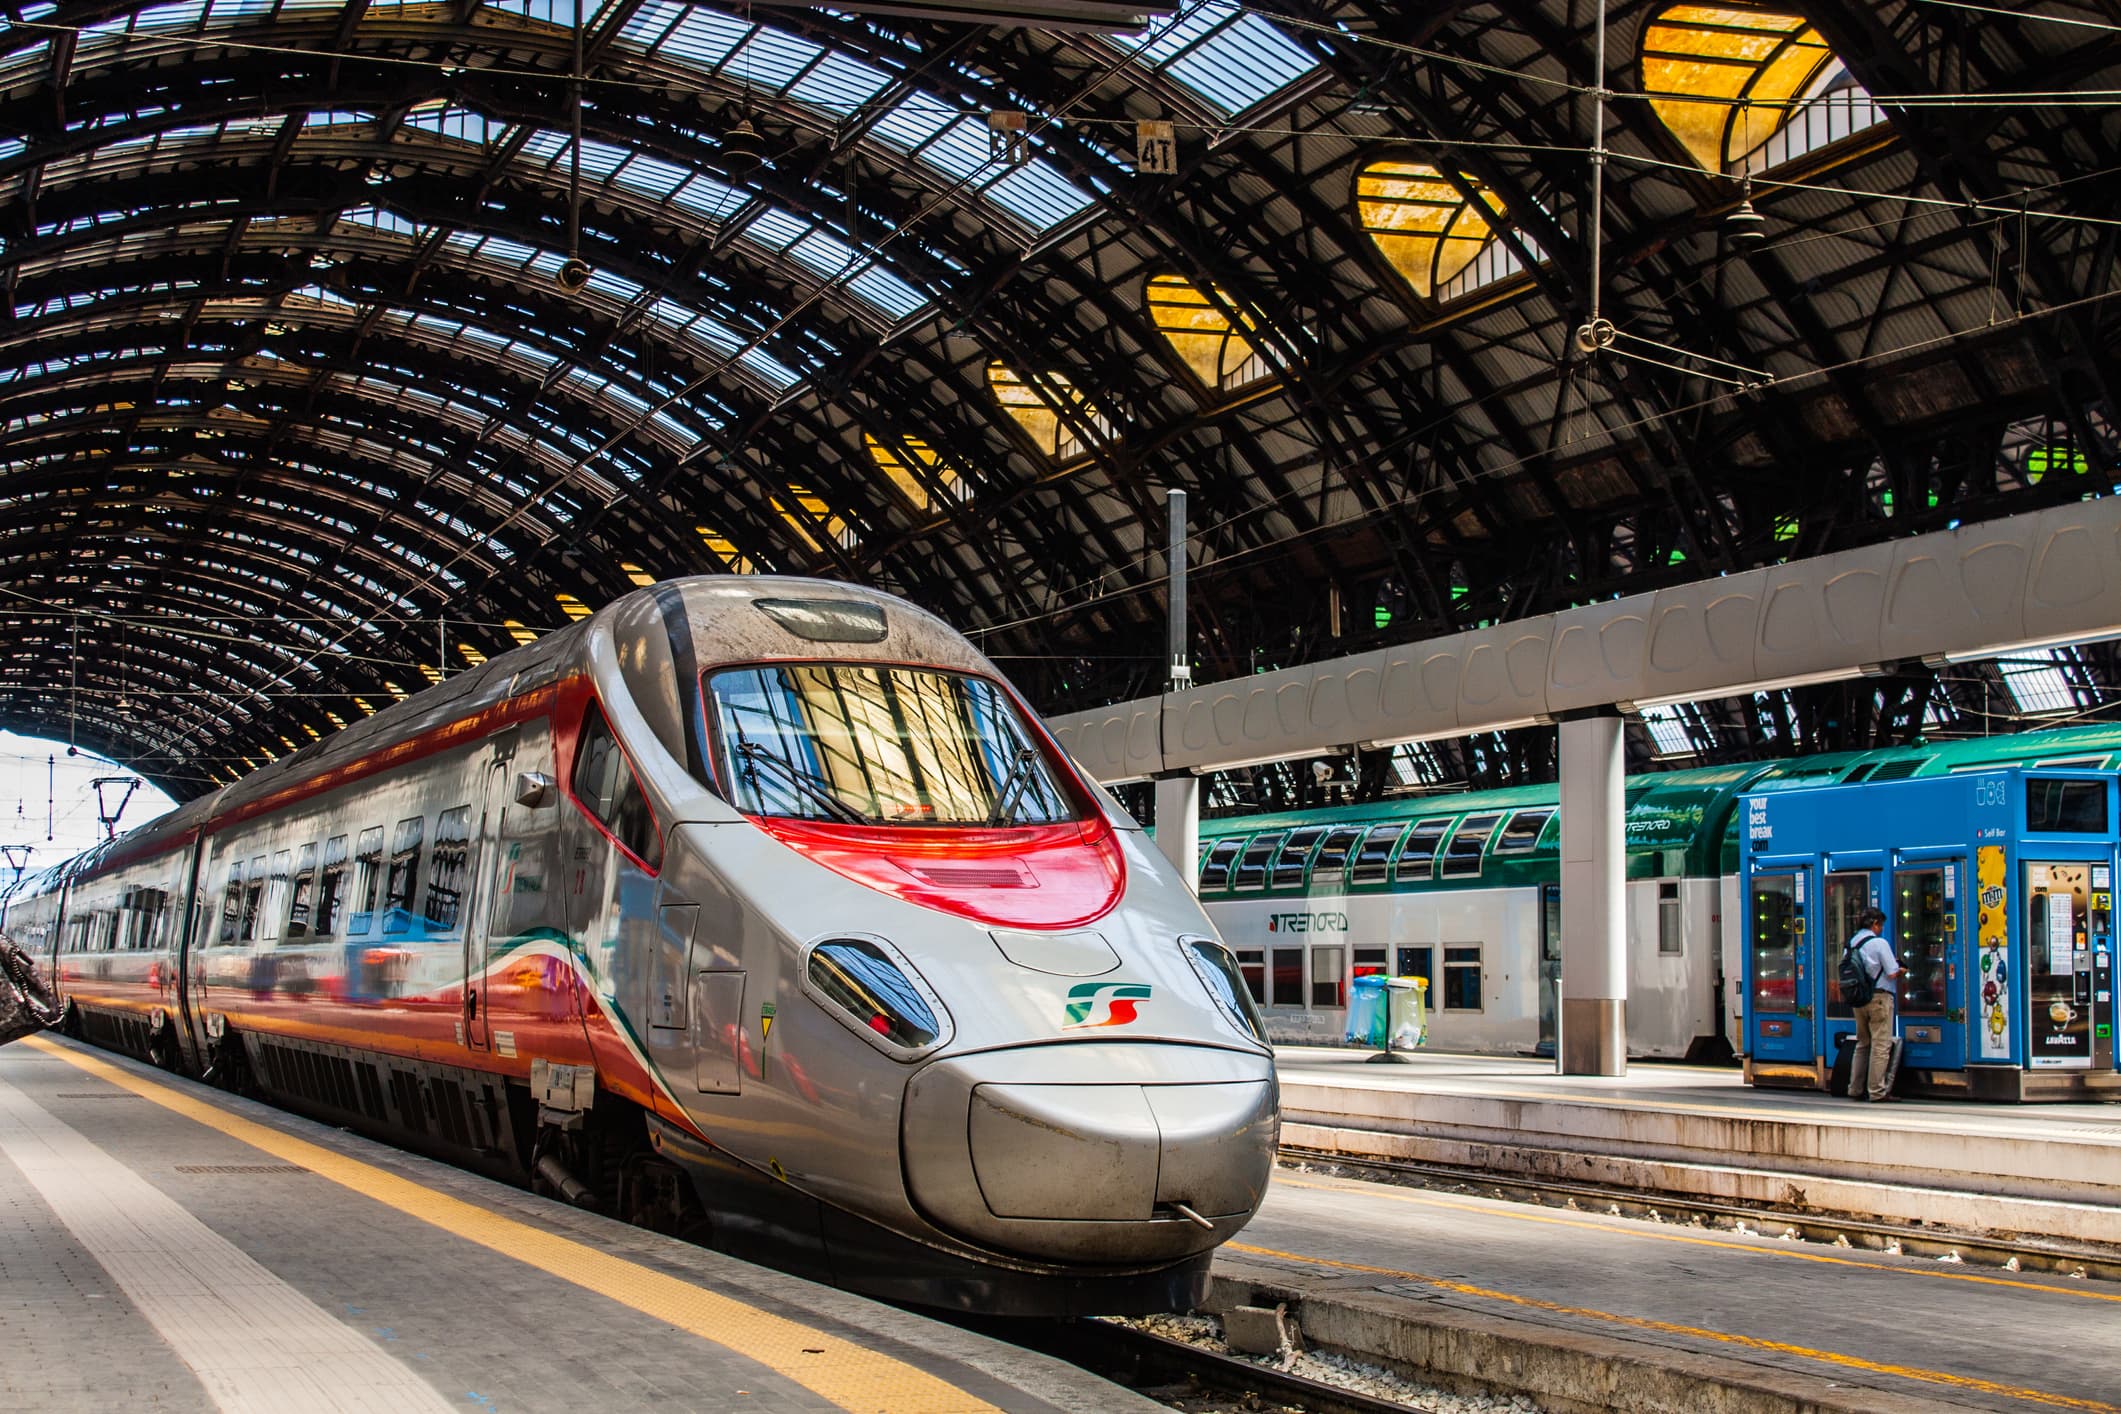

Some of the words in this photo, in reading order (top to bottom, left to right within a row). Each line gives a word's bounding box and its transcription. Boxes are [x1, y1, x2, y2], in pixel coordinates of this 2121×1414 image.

[1141, 139, 1171, 170] 4T
[1749, 798, 1768, 813] your
[1750, 811, 1767, 825] best
[1628, 820, 1671, 832] TRENORD
[1750, 825, 1773, 839] break
[1279, 912, 1348, 933] TRENORD
